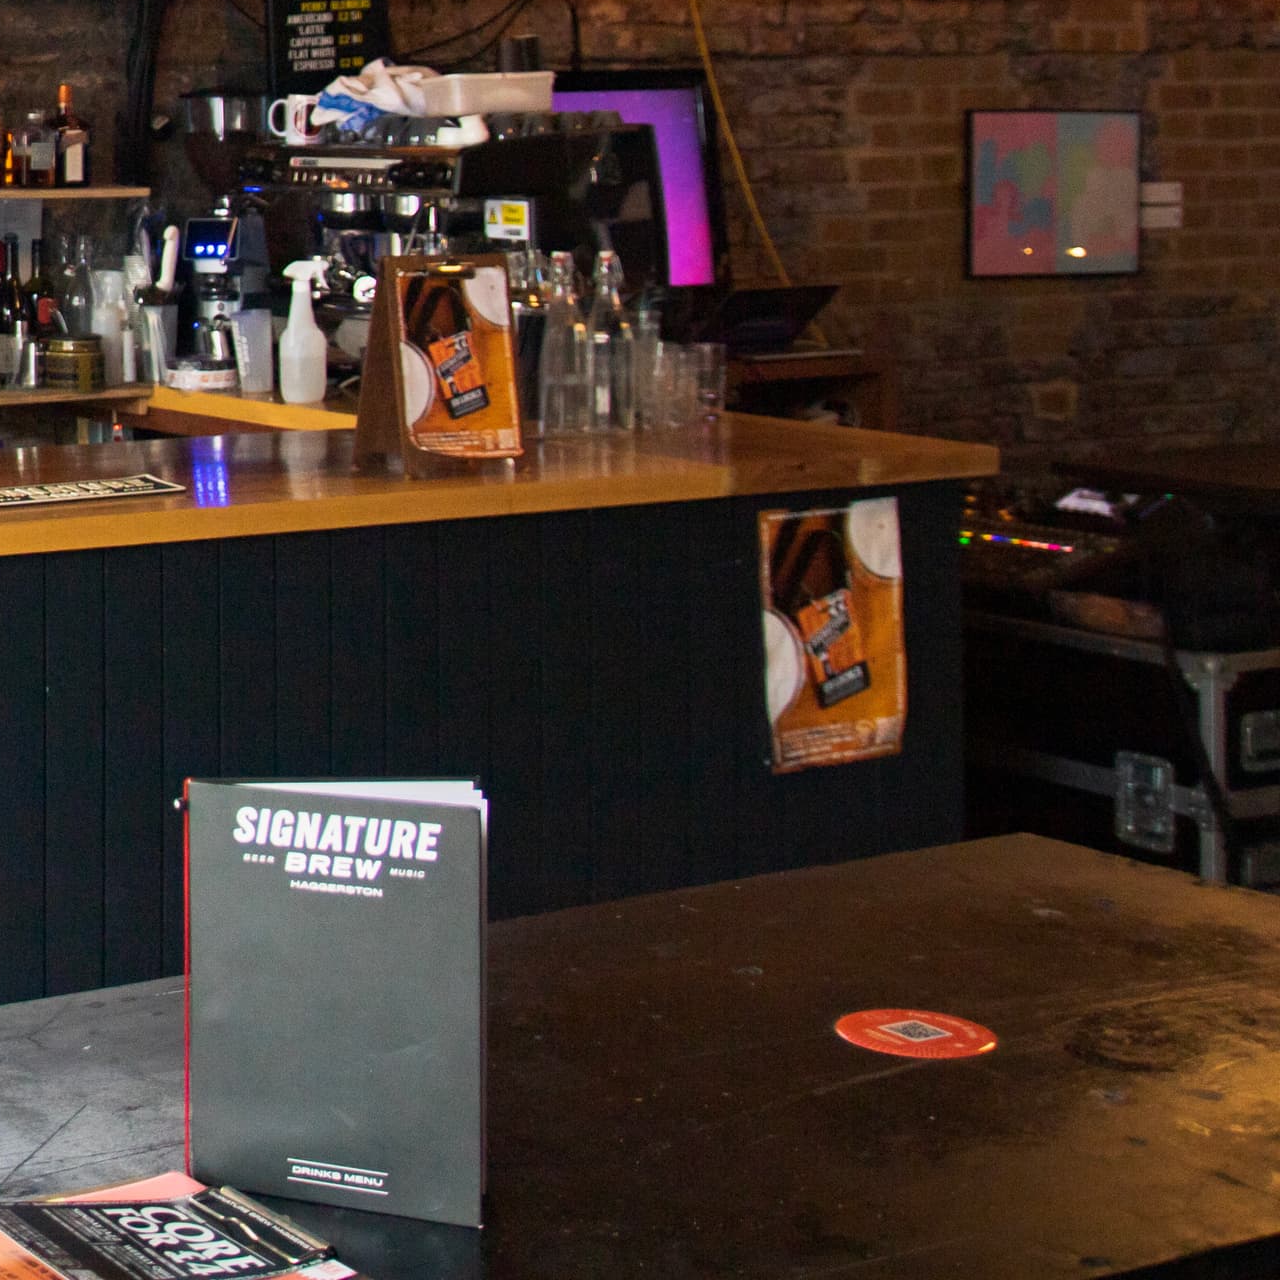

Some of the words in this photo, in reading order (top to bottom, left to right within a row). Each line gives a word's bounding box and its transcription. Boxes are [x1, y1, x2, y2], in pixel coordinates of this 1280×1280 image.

[232, 806, 442, 862] SIGNATURE
[284, 851, 383, 882] BREW
[389, 867, 426, 880] MUSIC
[290, 879, 383, 898] HAGGERSTON
[292, 1164, 340, 1180] DRINKS
[344, 1173, 383, 1188] MENU
[103, 1208, 179, 1247] FOR
[140, 1206, 266, 1274] CORE
